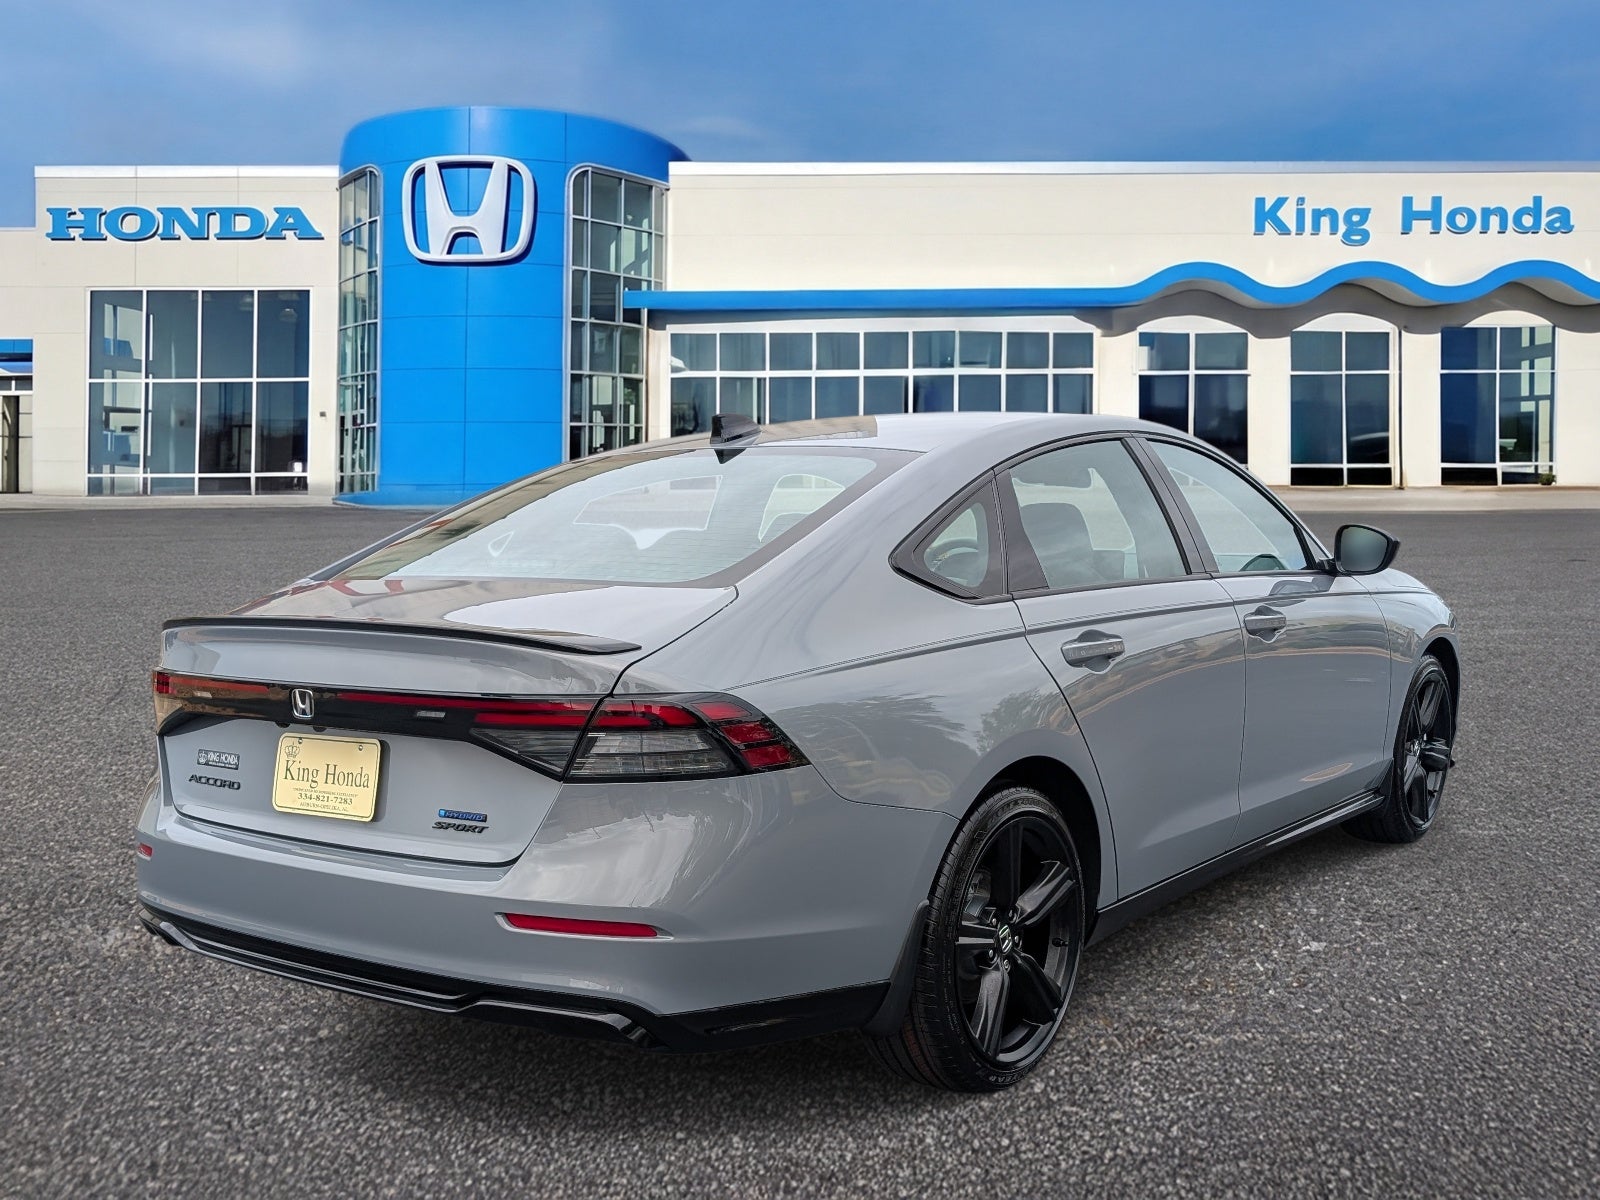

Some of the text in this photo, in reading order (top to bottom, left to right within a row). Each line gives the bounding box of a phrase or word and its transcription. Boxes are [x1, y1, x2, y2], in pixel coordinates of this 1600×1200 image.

[45, 206, 324, 240] HONDA
[1253, 195, 1575, 246] King Honda
[188, 774, 241, 790] ACCORD
[283, 759, 370, 789] King Honda
[297, 792, 353, 806] 334-821-7283
[445, 811, 483, 821] HYBRID
[431, 821, 490, 834] SPORT
